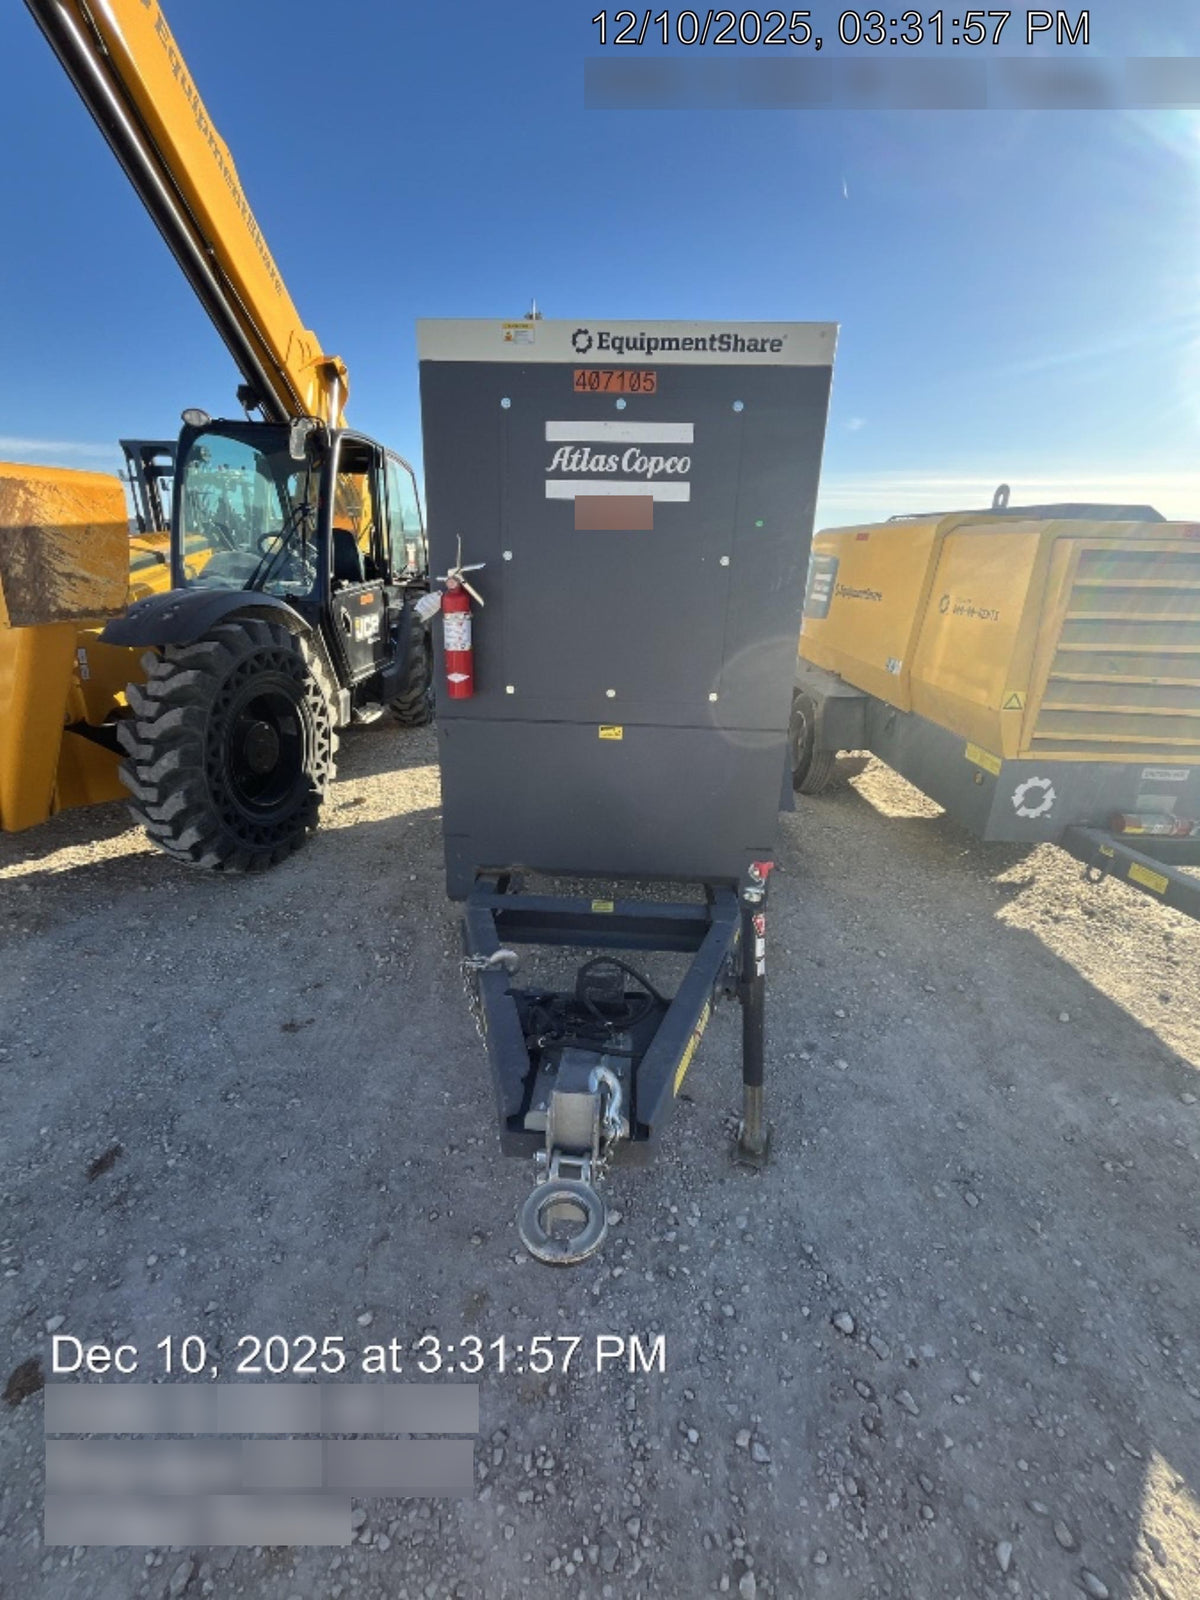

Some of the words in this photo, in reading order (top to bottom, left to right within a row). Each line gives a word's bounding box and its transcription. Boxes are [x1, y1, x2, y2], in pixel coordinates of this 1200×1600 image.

[596, 331, 784, 356] EquipmentShare
[573, 370, 657, 392] 407105
[545, 445, 620, 473] Atlas
[621, 447, 692, 479] Copco
